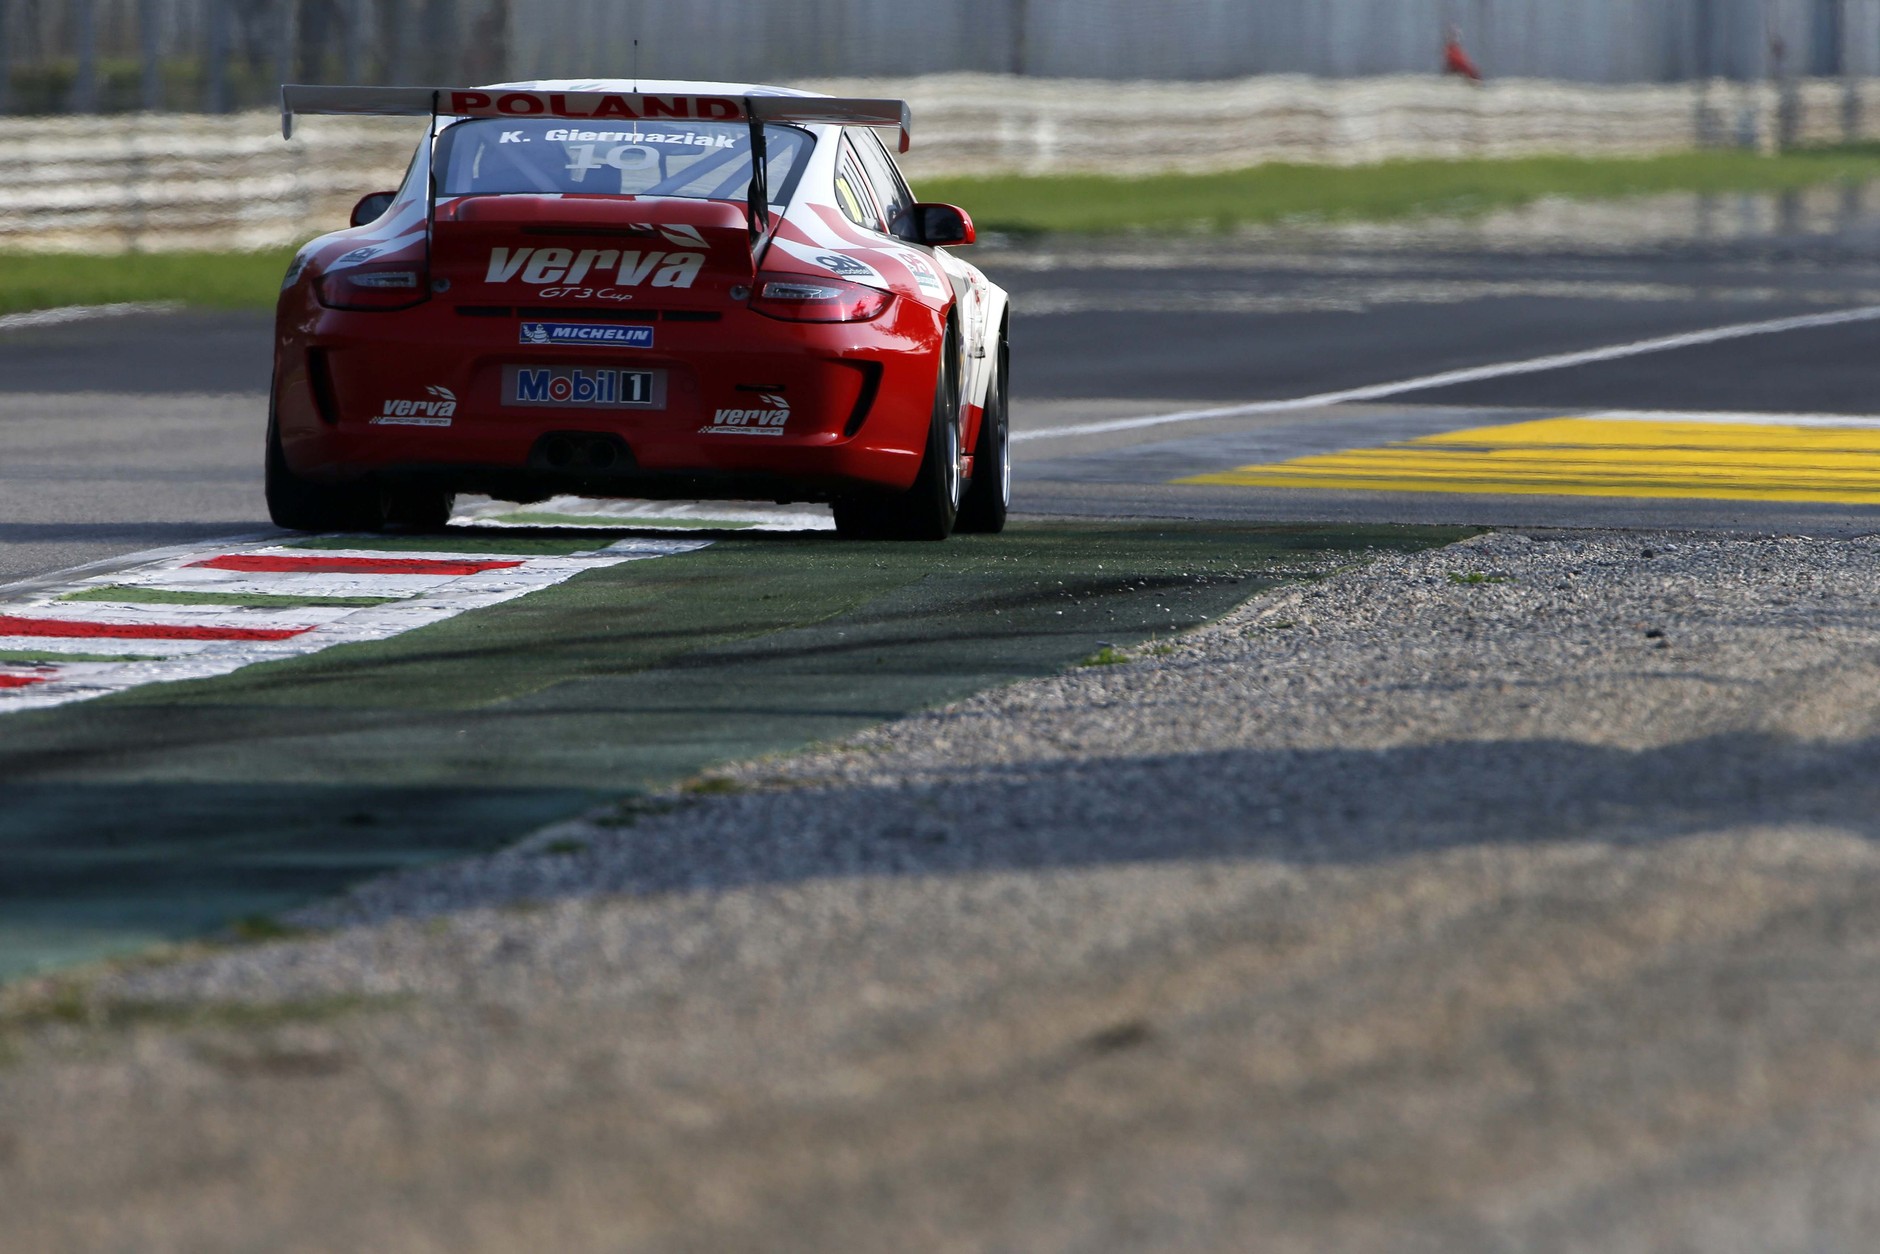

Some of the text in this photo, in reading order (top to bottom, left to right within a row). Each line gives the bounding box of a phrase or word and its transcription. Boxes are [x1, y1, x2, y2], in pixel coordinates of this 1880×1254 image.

[450, 92, 740, 119] POLAND
[499, 129, 734, 149] K. Giermaziak
[565, 144, 660, 170] 10
[485, 247, 706, 288] verva
[597, 288, 633, 301] Cup
[552, 327, 650, 341] MICHELIN
[516, 369, 616, 403] Mobil
[383, 400, 457, 417] verva
[713, 409, 791, 426] verva
